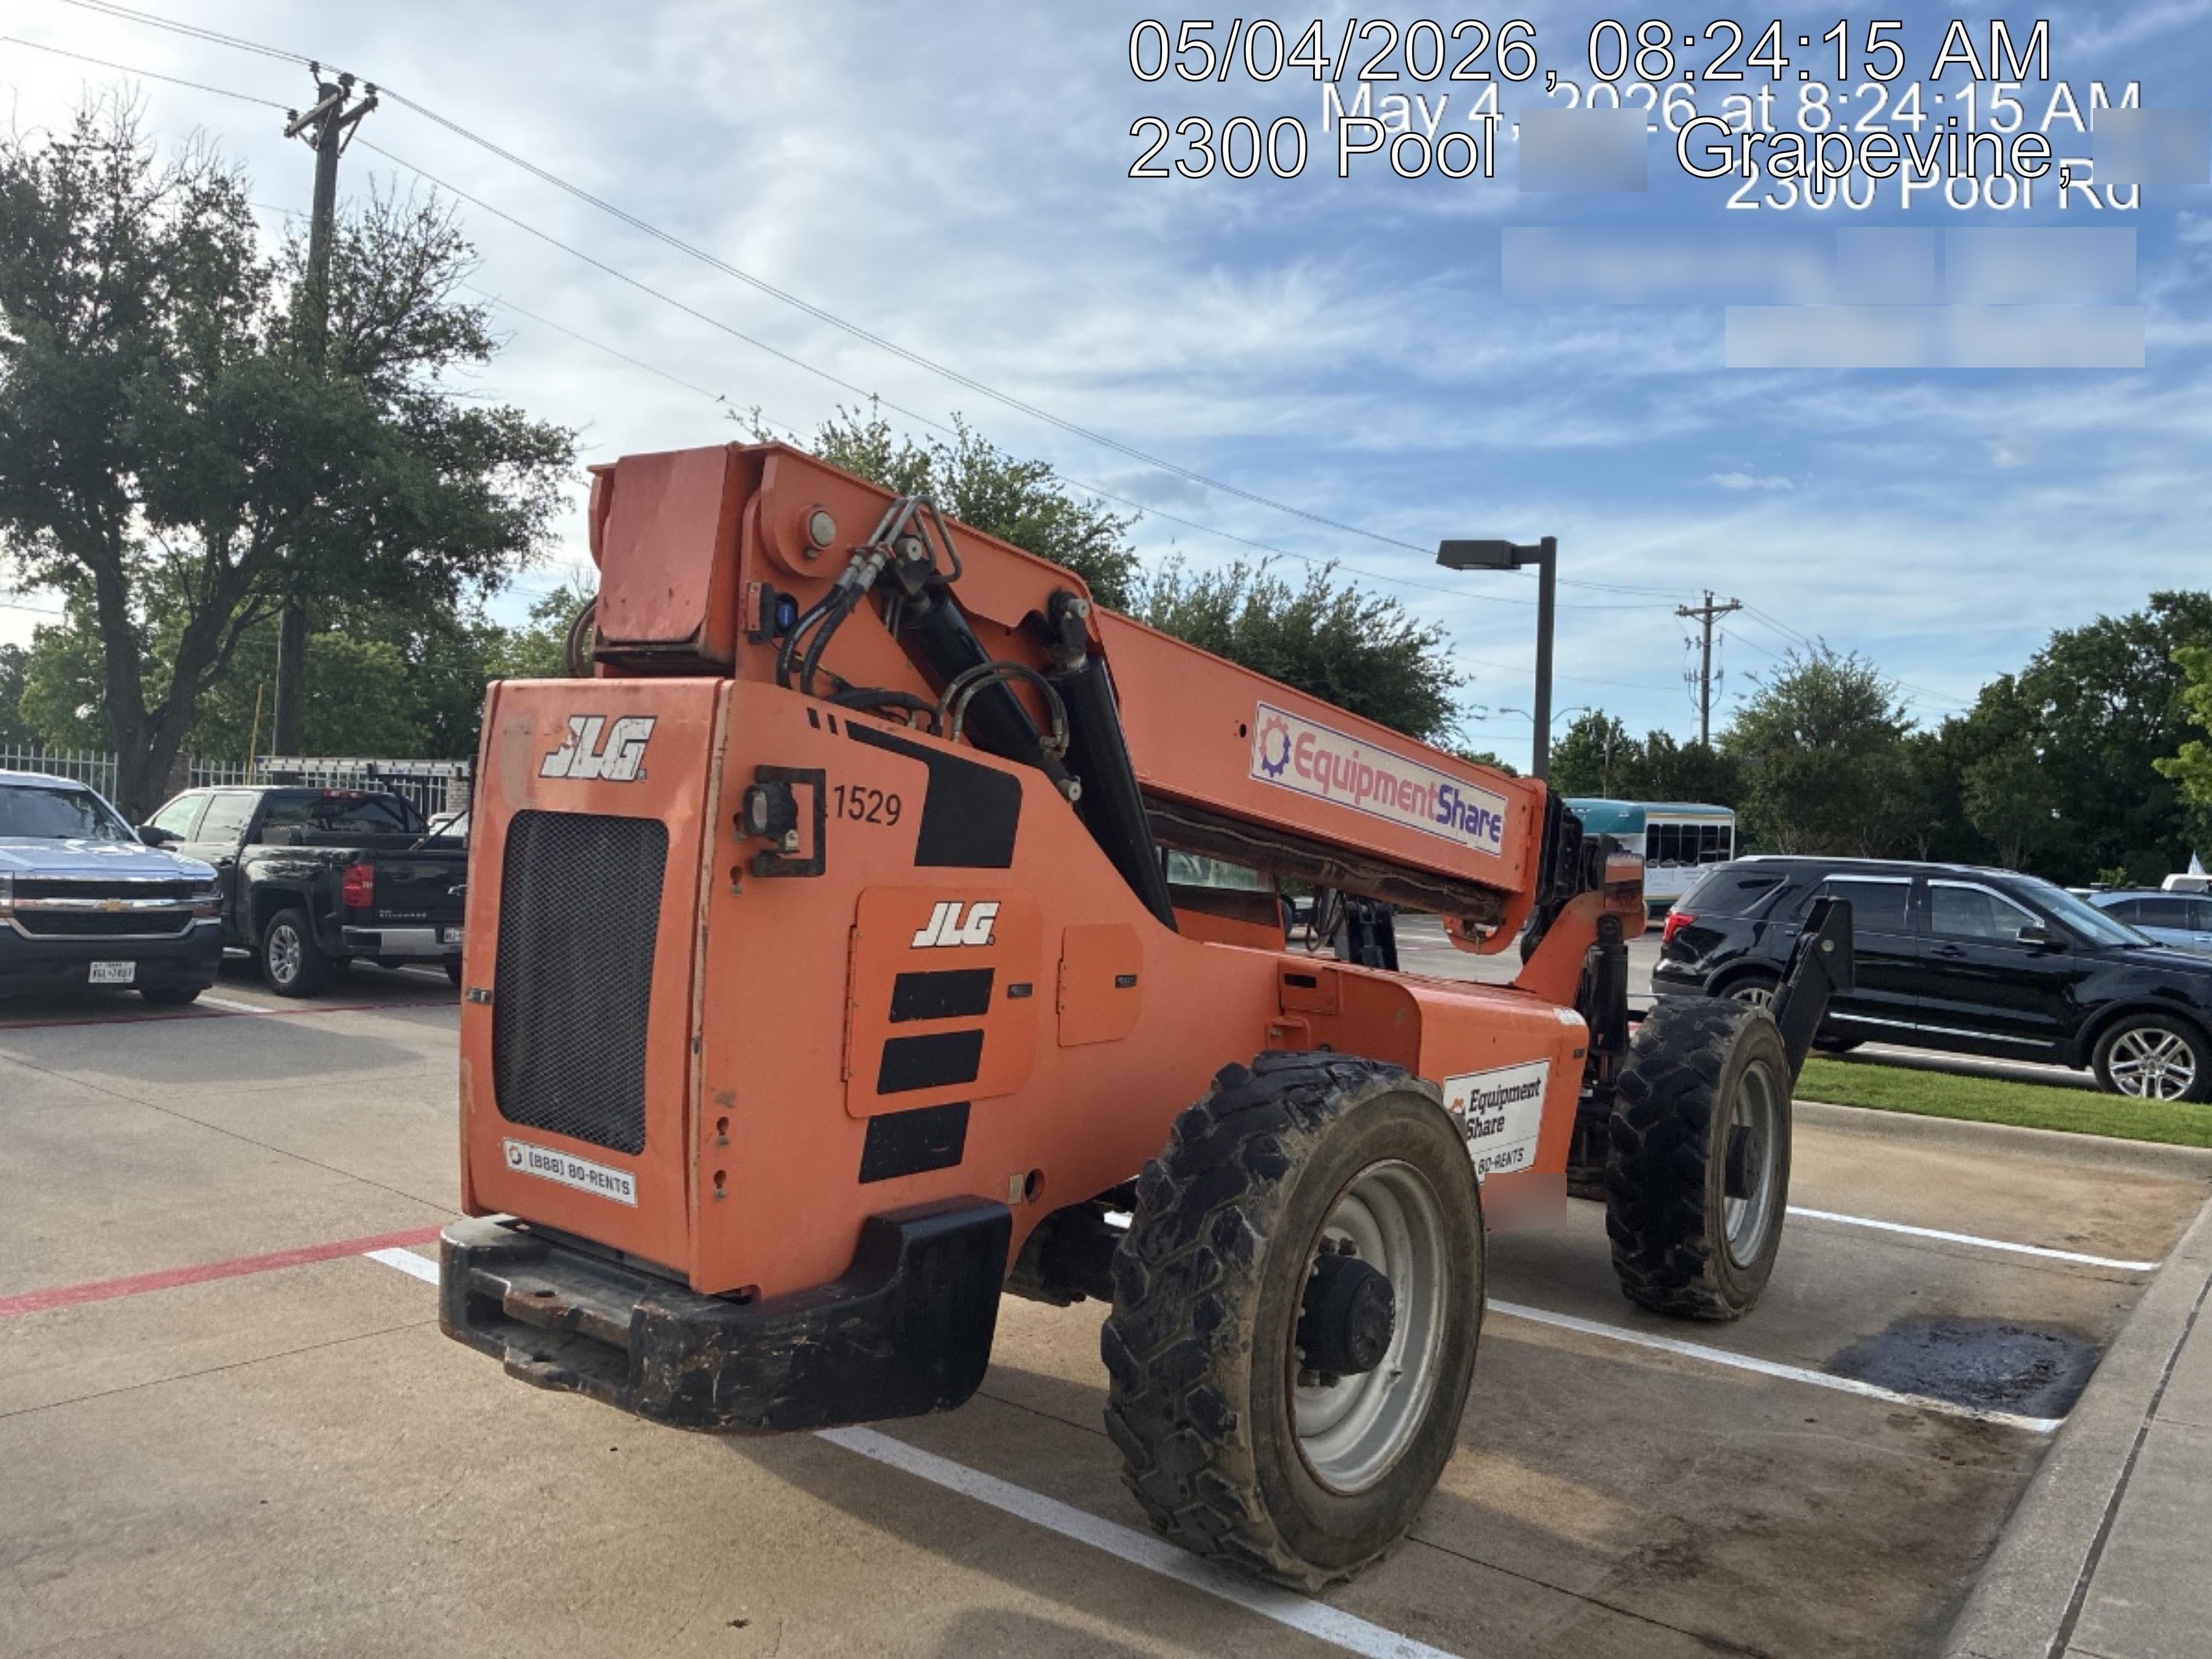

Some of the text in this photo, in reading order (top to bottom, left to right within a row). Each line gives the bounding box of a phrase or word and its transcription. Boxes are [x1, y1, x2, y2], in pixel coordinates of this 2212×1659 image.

[539, 715, 658, 783] JLG
[833, 785, 902, 826] 1529
[1294, 731, 1503, 844] EquipmentShare
[910, 901, 1001, 949] JLG
[1469, 1077, 1542, 1115] Equipment
[1466, 1115, 1505, 1141] Share
[529, 1151, 631, 1195] (888) 80-RENTS
